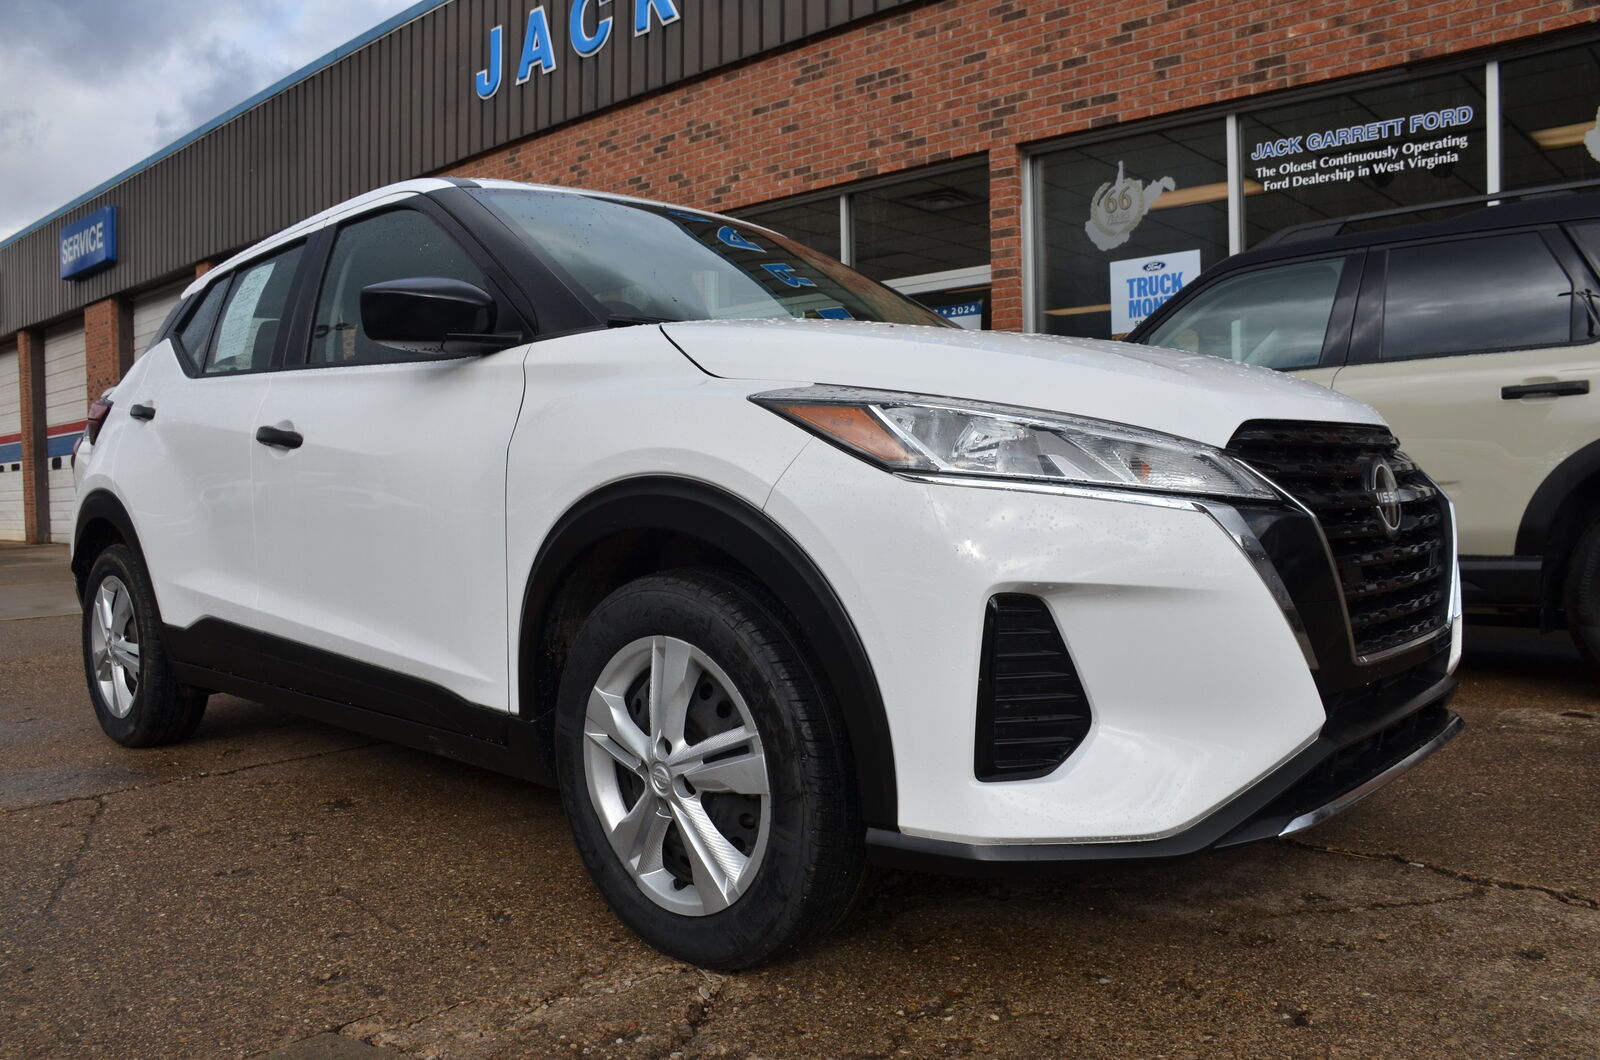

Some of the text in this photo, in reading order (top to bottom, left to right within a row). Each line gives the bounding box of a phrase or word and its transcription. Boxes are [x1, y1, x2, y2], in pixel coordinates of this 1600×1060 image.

[1250, 106, 1474, 161] JACK GARRETT FORD
[1255, 167, 1277, 179] The
[1319, 145, 1399, 169] Continuously
[1402, 135, 1469, 156] Operating
[1263, 152, 1459, 192] Ford Dealership in West Virginia
[1104, 185, 1133, 214] 66
[62, 221, 104, 265] SERVICE
[1126, 271, 1184, 299] TRUCK
[951, 304, 976, 315] 2024
[1128, 295, 1172, 319] MON
